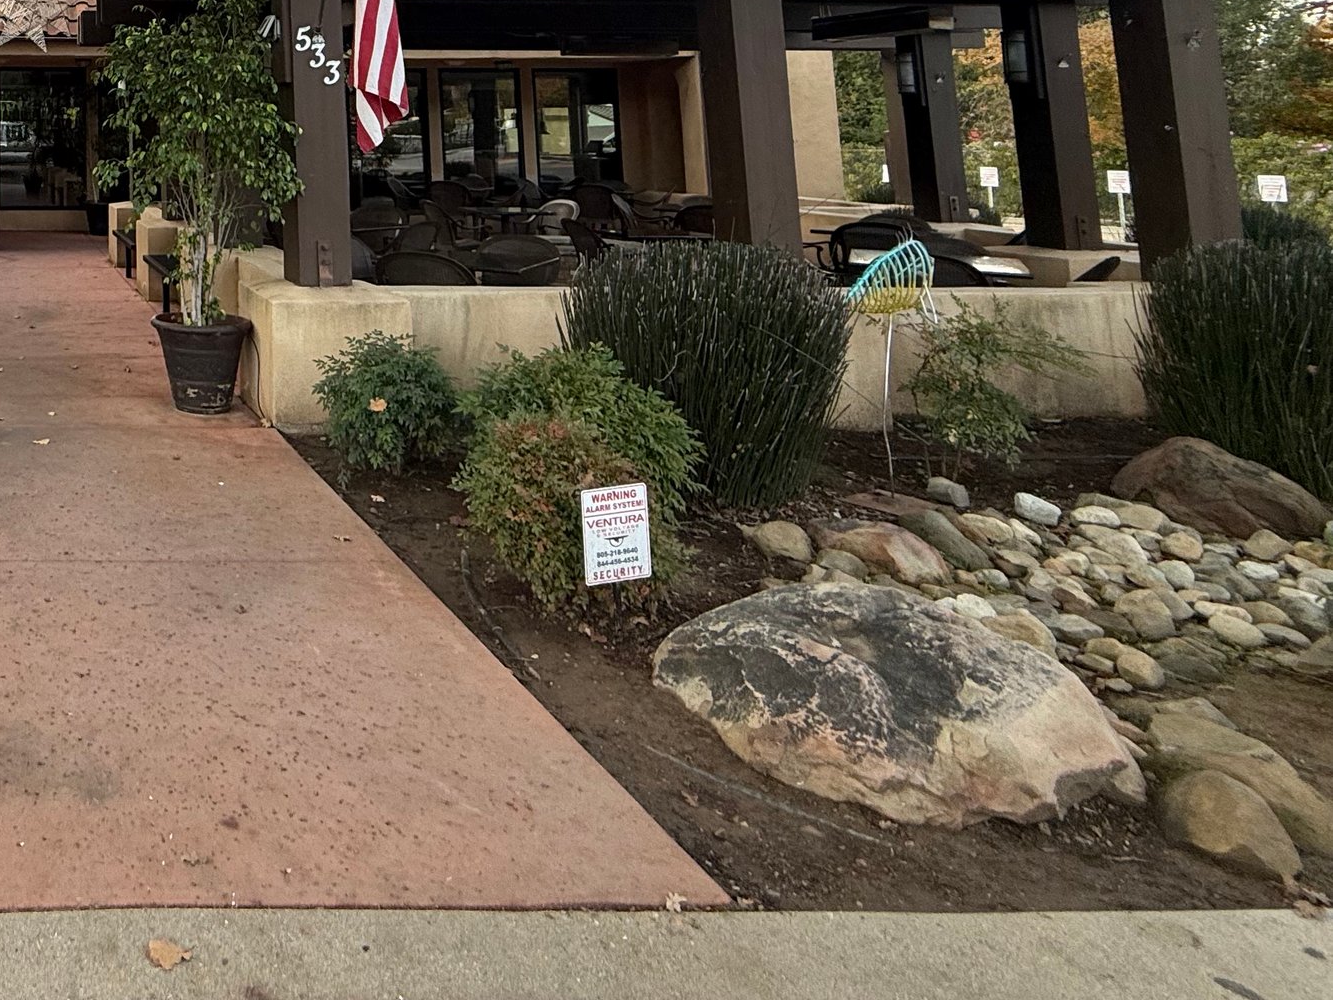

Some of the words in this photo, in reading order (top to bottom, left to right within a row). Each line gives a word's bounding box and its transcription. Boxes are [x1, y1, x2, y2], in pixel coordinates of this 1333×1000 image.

[295, 25, 341, 85] 533
[591, 489, 637, 504] WARNING
[585, 504, 611, 513] ALARM
[613, 499, 644, 510] SYSTEM!
[586, 513, 645, 529] VENTURA
[593, 565, 643, 580] SECURITY
